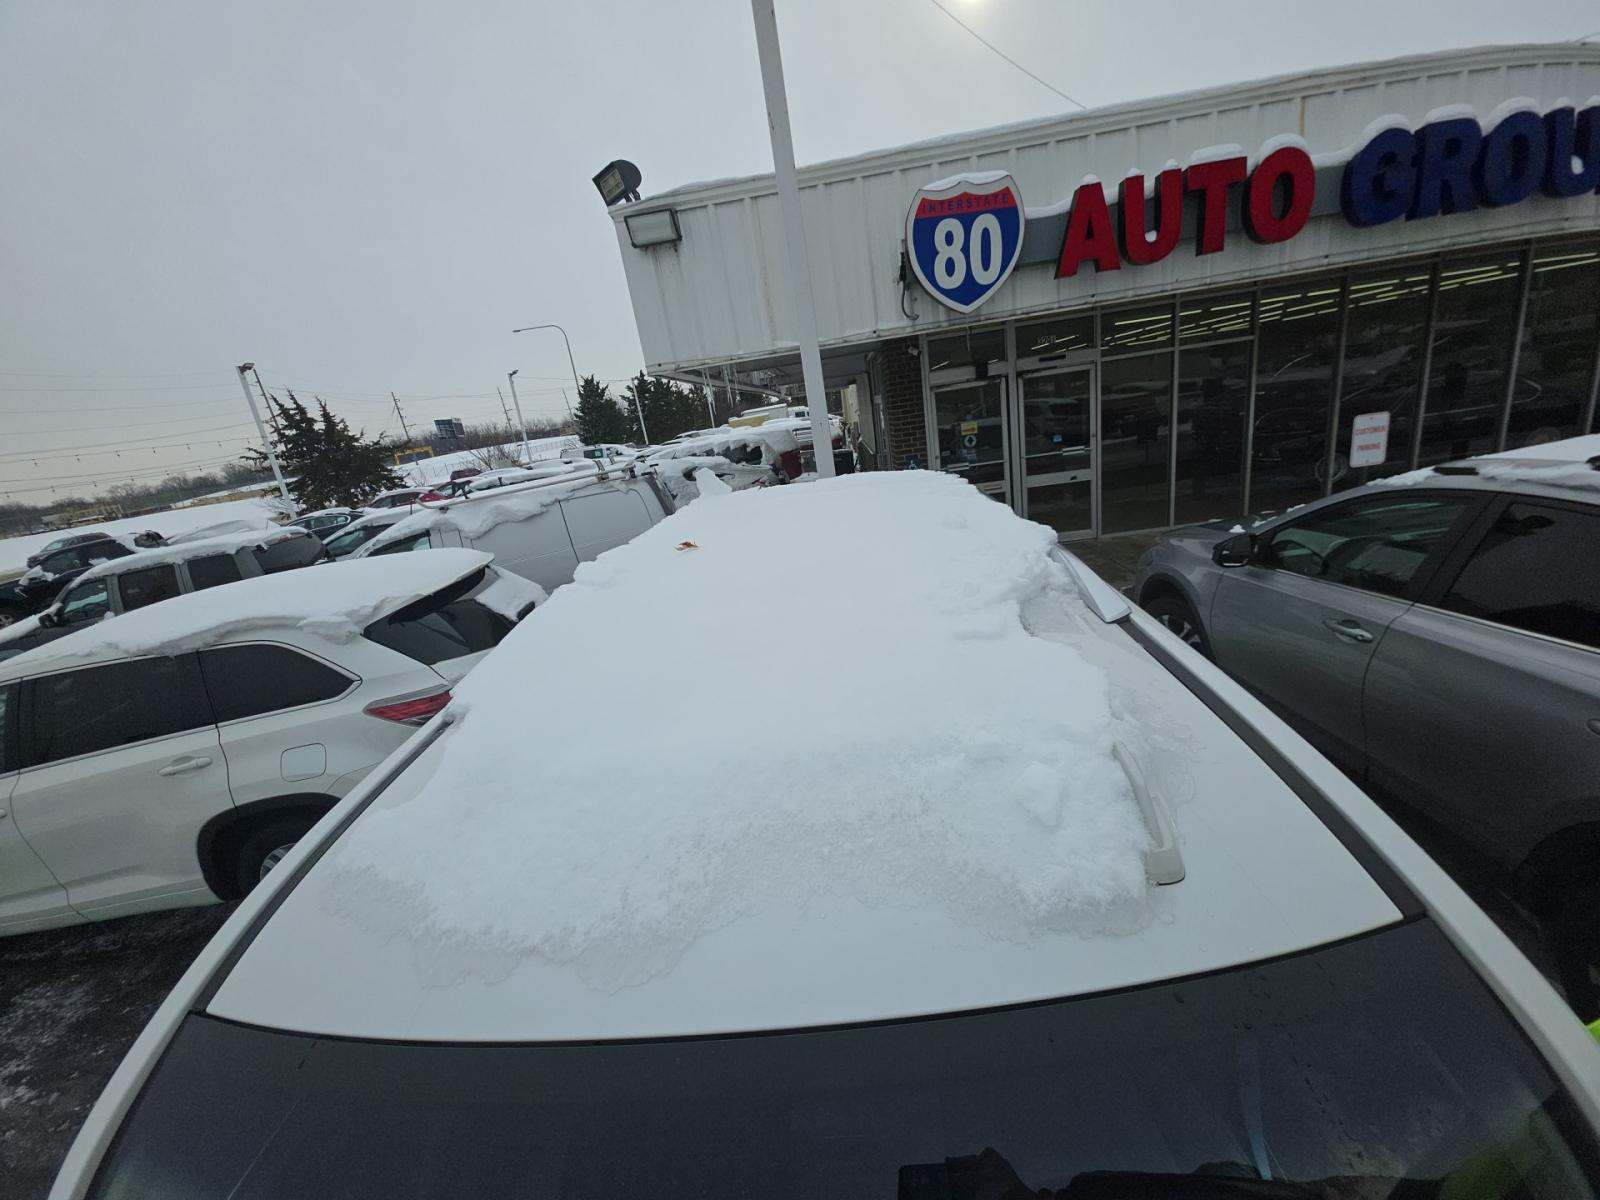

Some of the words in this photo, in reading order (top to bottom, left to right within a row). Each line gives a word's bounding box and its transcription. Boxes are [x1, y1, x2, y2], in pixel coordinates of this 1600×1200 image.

[921, 192, 1009, 213] INTERSTATE
[1056, 146, 1316, 280] AUTO
[1340, 106, 1600, 228] GROU
[934, 213, 1002, 290] 80
